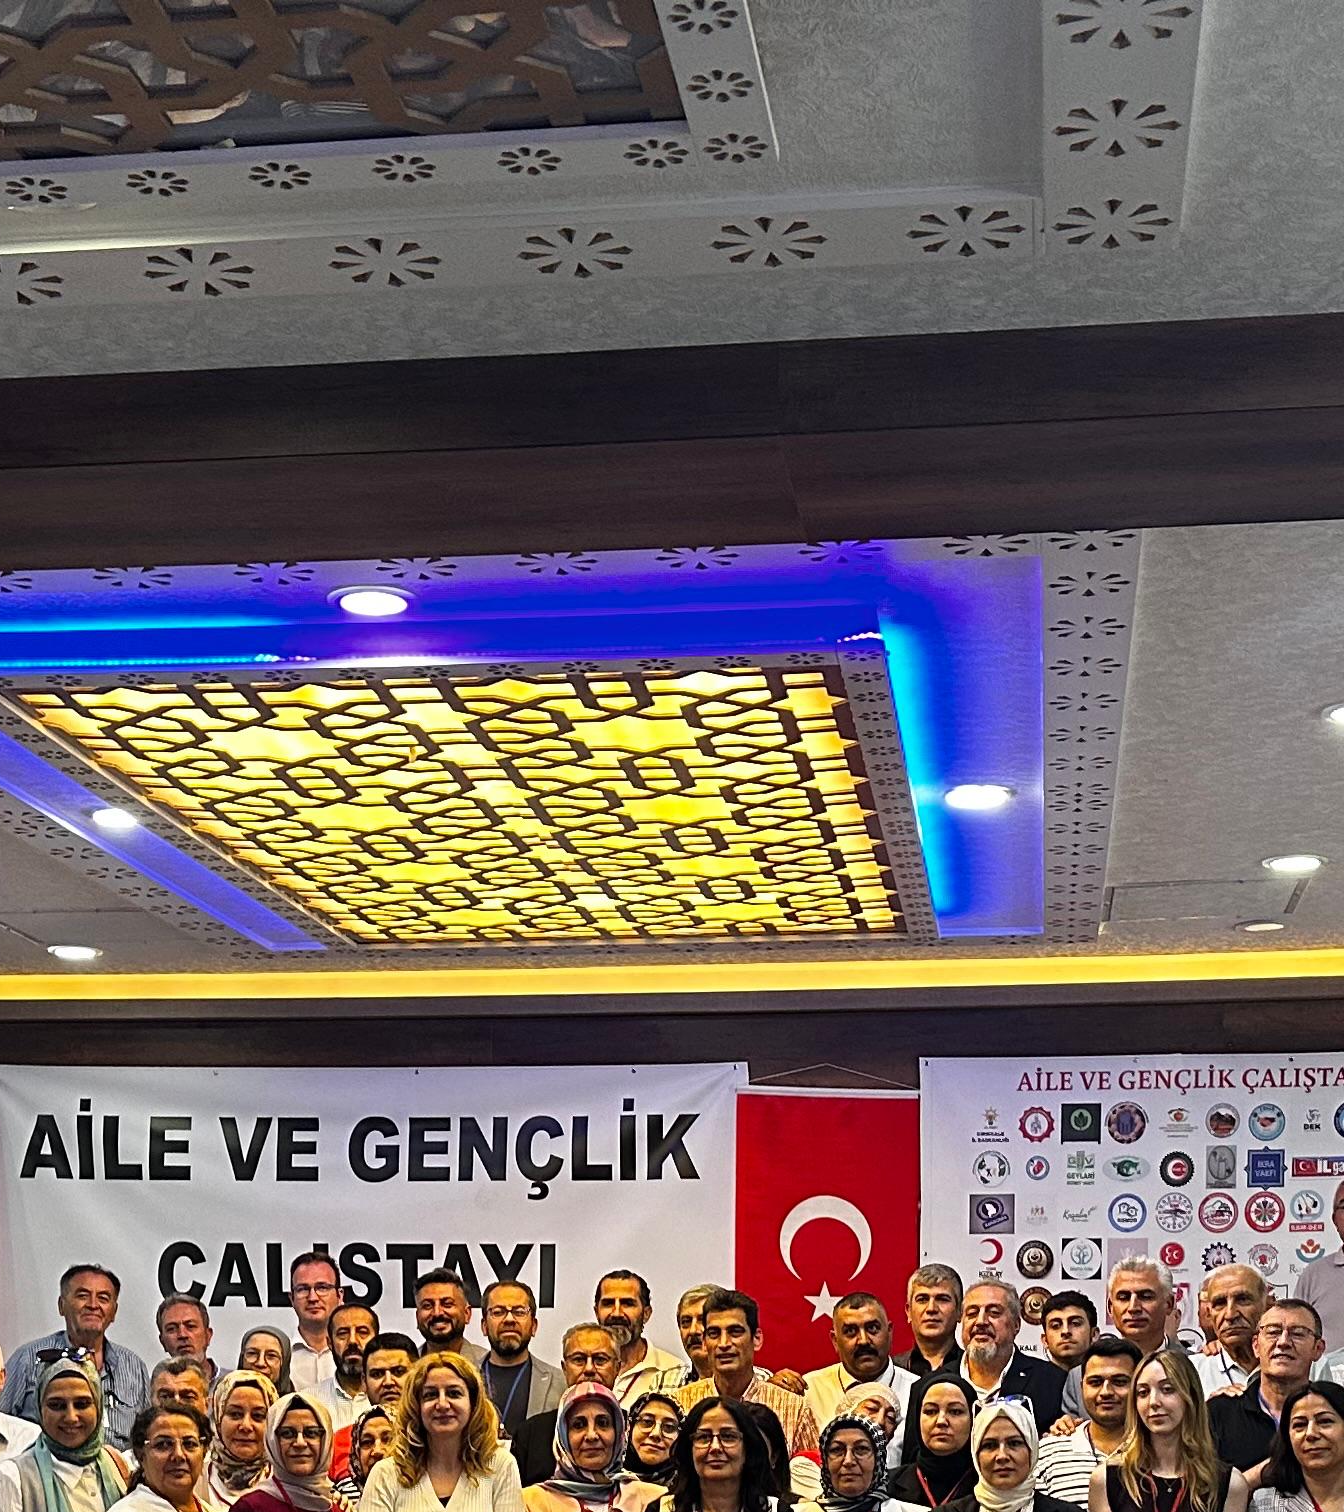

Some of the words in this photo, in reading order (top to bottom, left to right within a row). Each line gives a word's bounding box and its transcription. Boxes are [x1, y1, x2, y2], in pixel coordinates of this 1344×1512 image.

[1016, 1067, 1073, 1092] AİLE
[1079, 1070, 1112, 1090] VE
[1118, 1064, 1236, 1095] GENÇLİK
[20, 1098, 192, 1180] AİLE
[219, 1117, 320, 1182] VE
[348, 1098, 701, 1200] GENÇLİK
